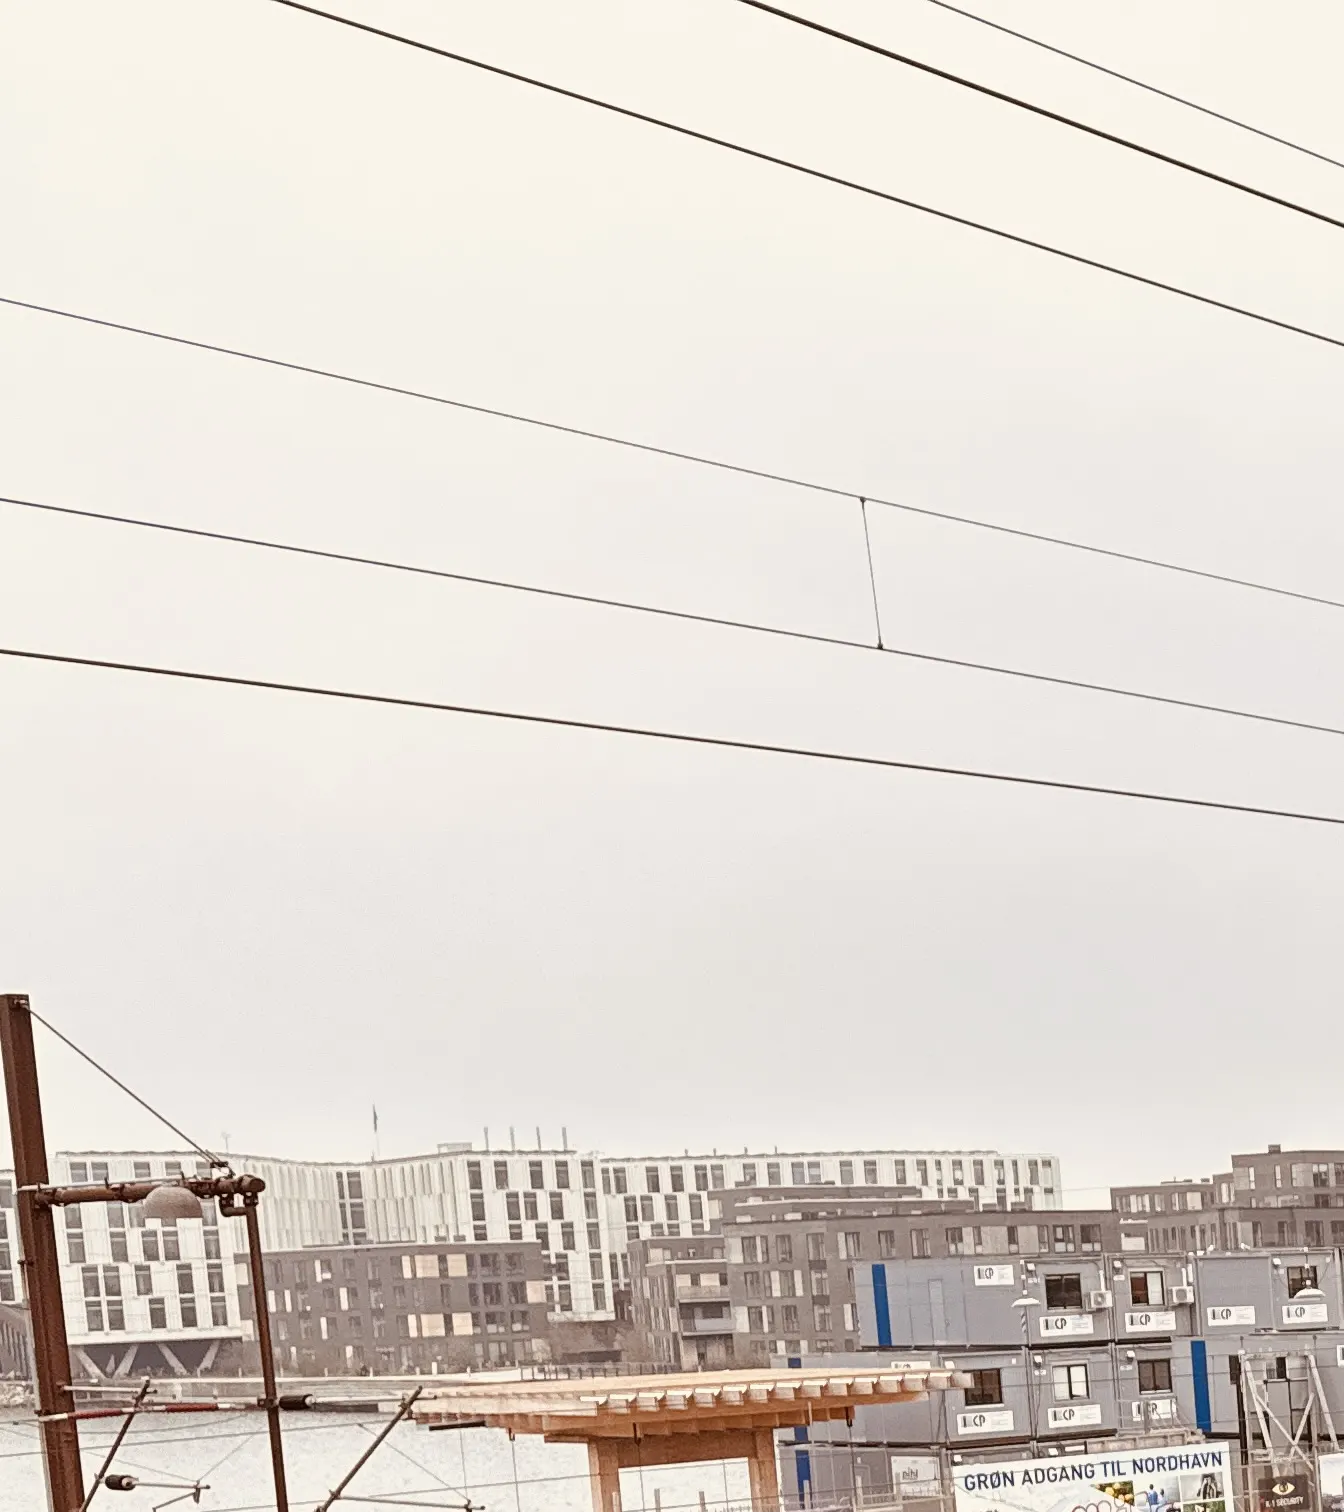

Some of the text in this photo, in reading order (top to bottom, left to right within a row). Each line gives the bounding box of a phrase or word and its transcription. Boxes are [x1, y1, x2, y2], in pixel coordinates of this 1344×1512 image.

[964, 1452, 1223, 1491] GRØN ADGANG TIL NORDHAVN
[1276, 1496, 1304, 1507] SECURITY
